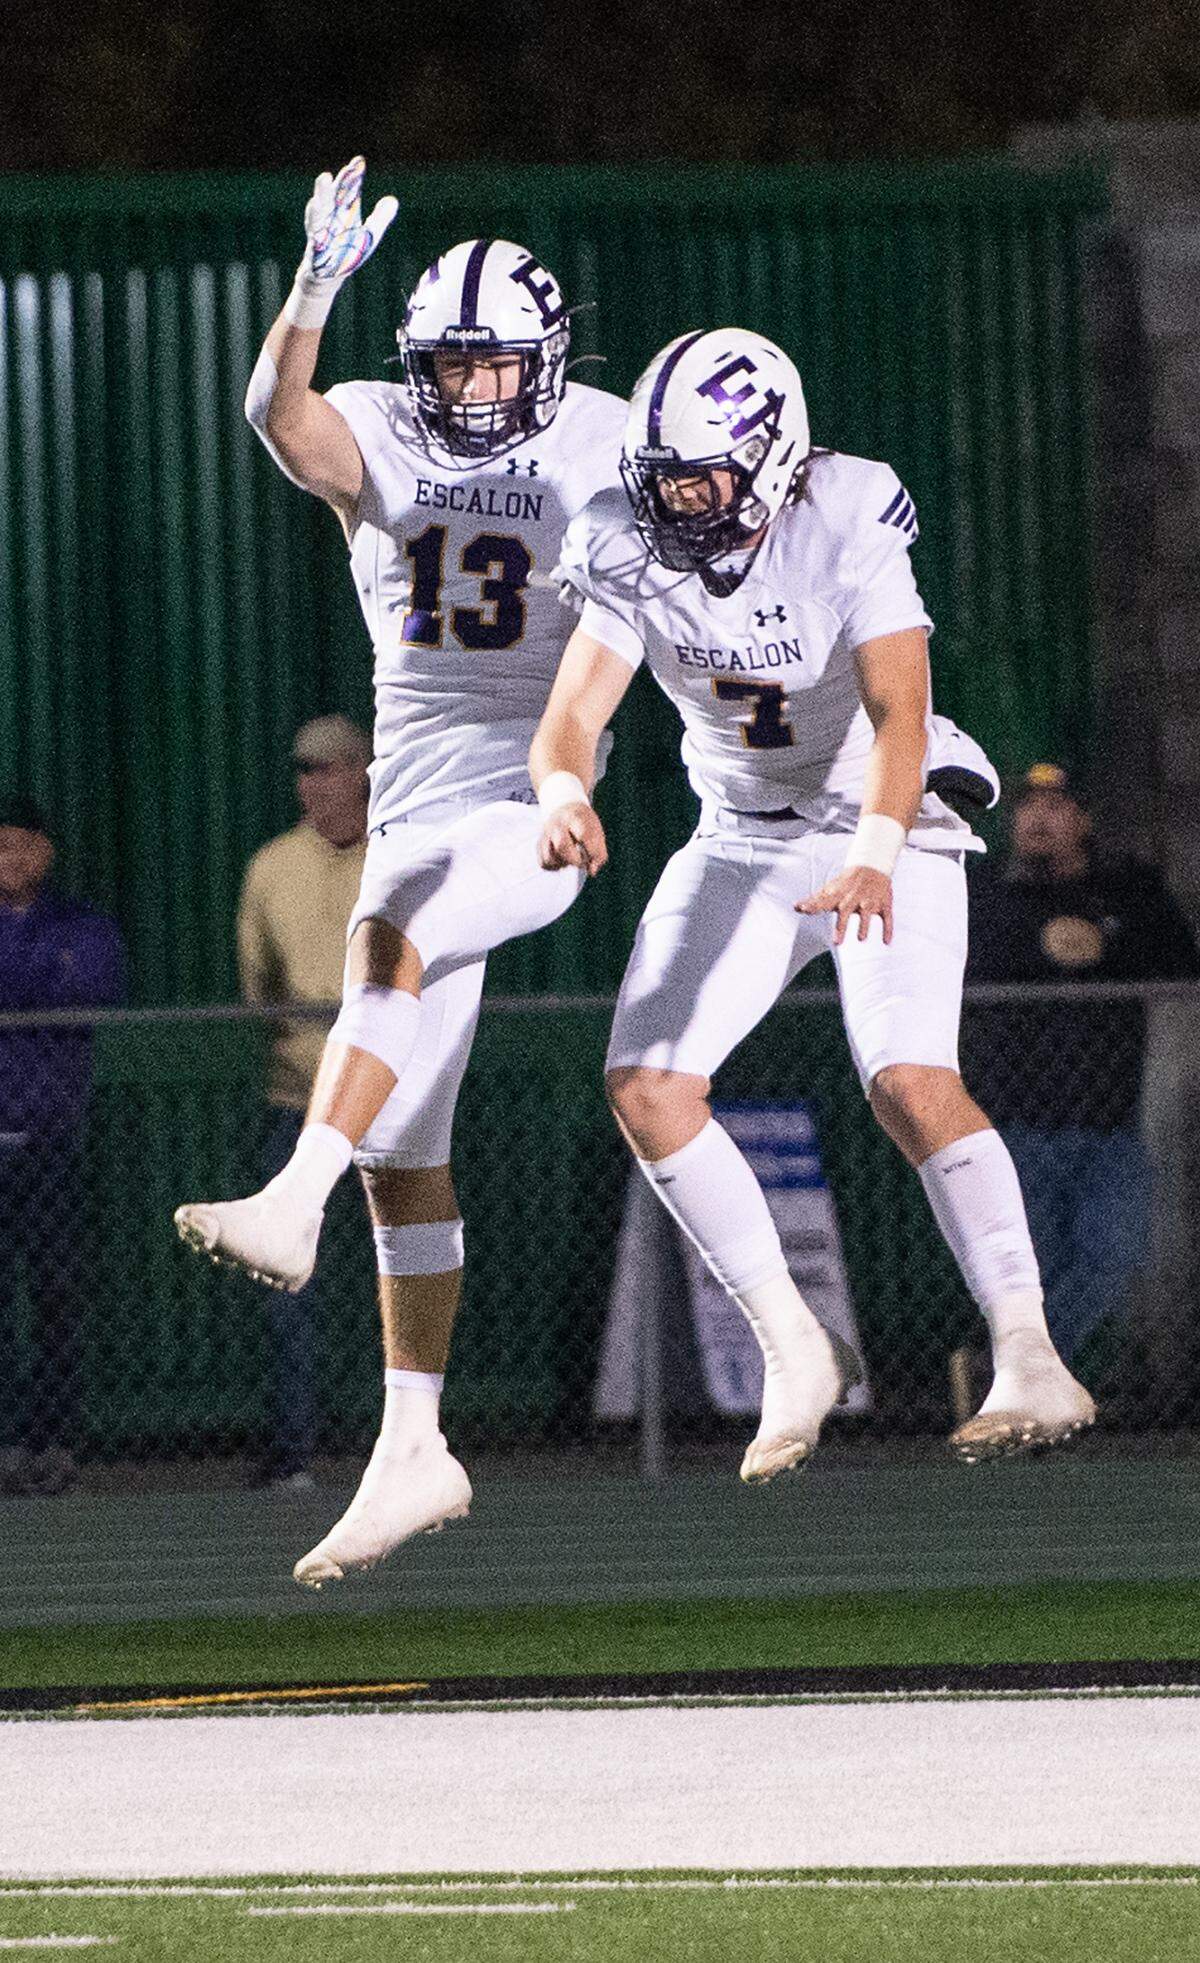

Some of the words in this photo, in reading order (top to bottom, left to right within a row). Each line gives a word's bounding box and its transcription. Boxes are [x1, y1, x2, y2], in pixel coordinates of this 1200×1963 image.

[509, 257, 563, 330] E
[446, 329, 491, 342] Riddell
[695, 355, 782, 440] E
[414, 478, 544, 521] ESCALON
[401, 522, 536, 652] 13
[675, 638, 803, 671] ESCALON
[711, 676, 796, 751] 7
